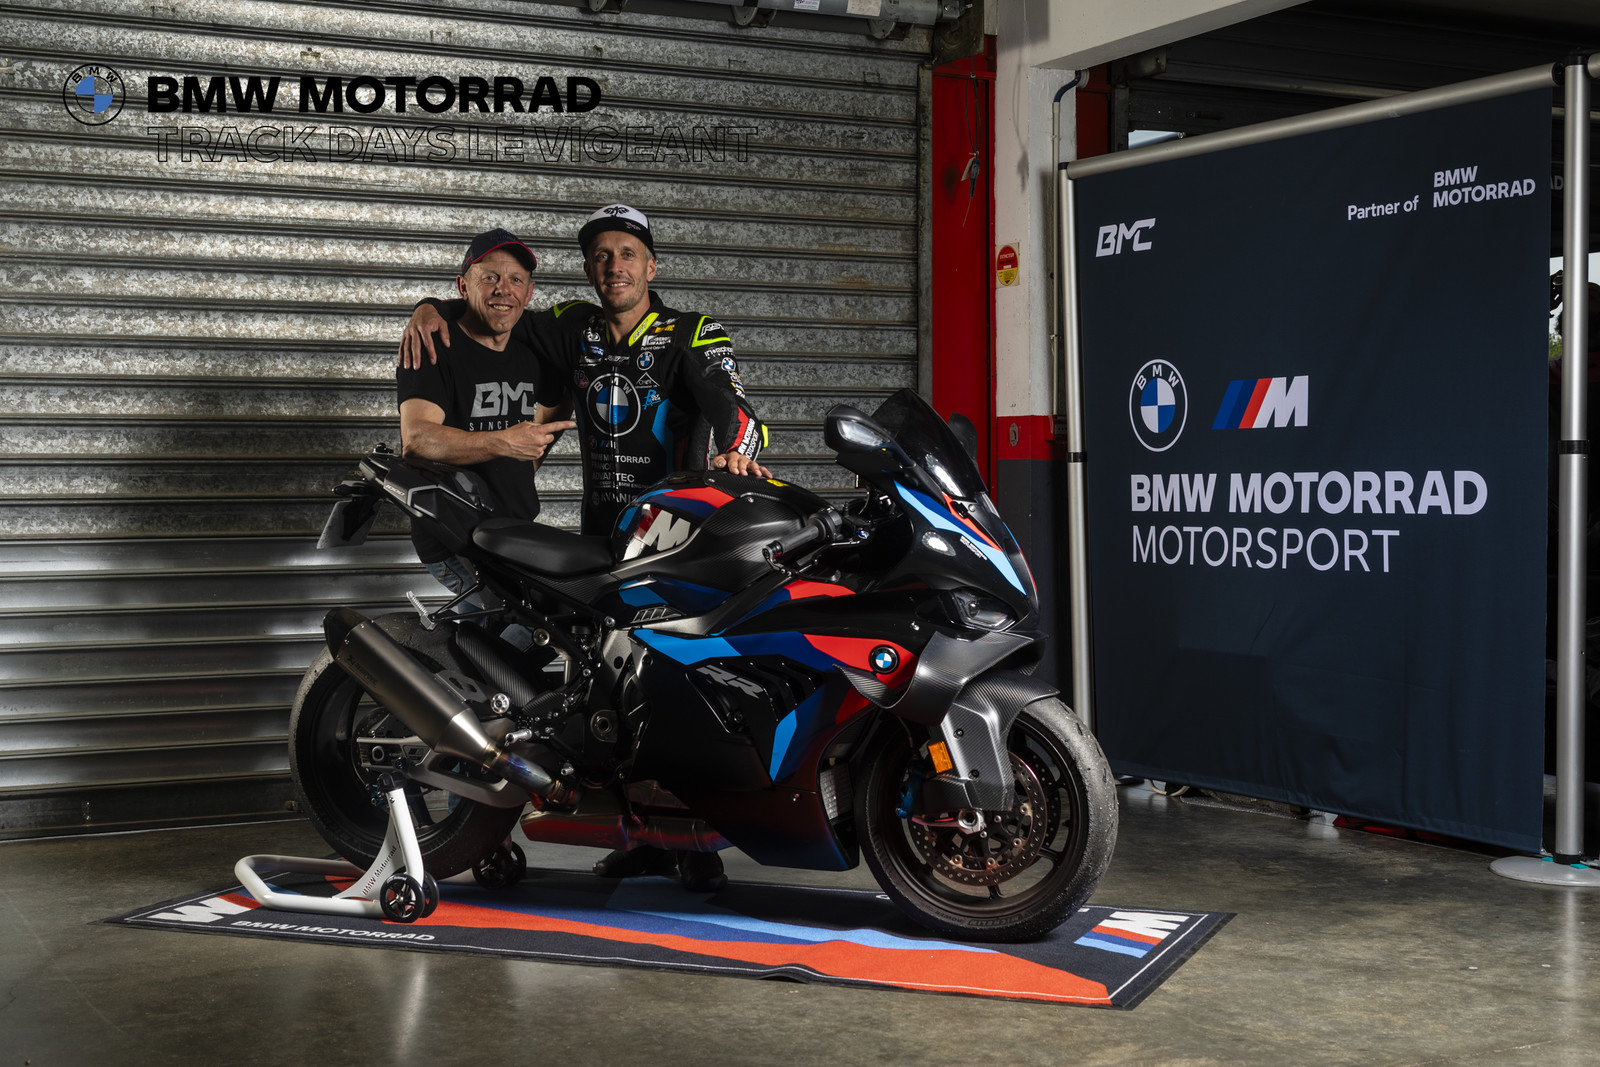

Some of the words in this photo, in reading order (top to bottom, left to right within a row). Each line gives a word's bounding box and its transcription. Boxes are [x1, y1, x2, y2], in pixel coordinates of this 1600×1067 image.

[1432, 178, 1536, 208] MOTORRAD
[1433, 166, 1479, 189] BMW
[1347, 199, 1400, 221] Partner
[1403, 195, 1419, 214] of
[1095, 218, 1156, 257] BMC
[470, 381, 535, 418] BMC
[469, 420, 509, 432] SINCE
[1131, 473, 1217, 513] BMW
[1228, 470, 1488, 515] MOTORRAD
[1132, 525, 1400, 573] MOTORSPORT
[695, 664, 764, 700] RR
[362, 876, 376, 896] BMW
[374, 845, 398, 878] Motorrad
[230, 920, 291, 932] BMW
[296, 925, 436, 942] MOTORRAD
